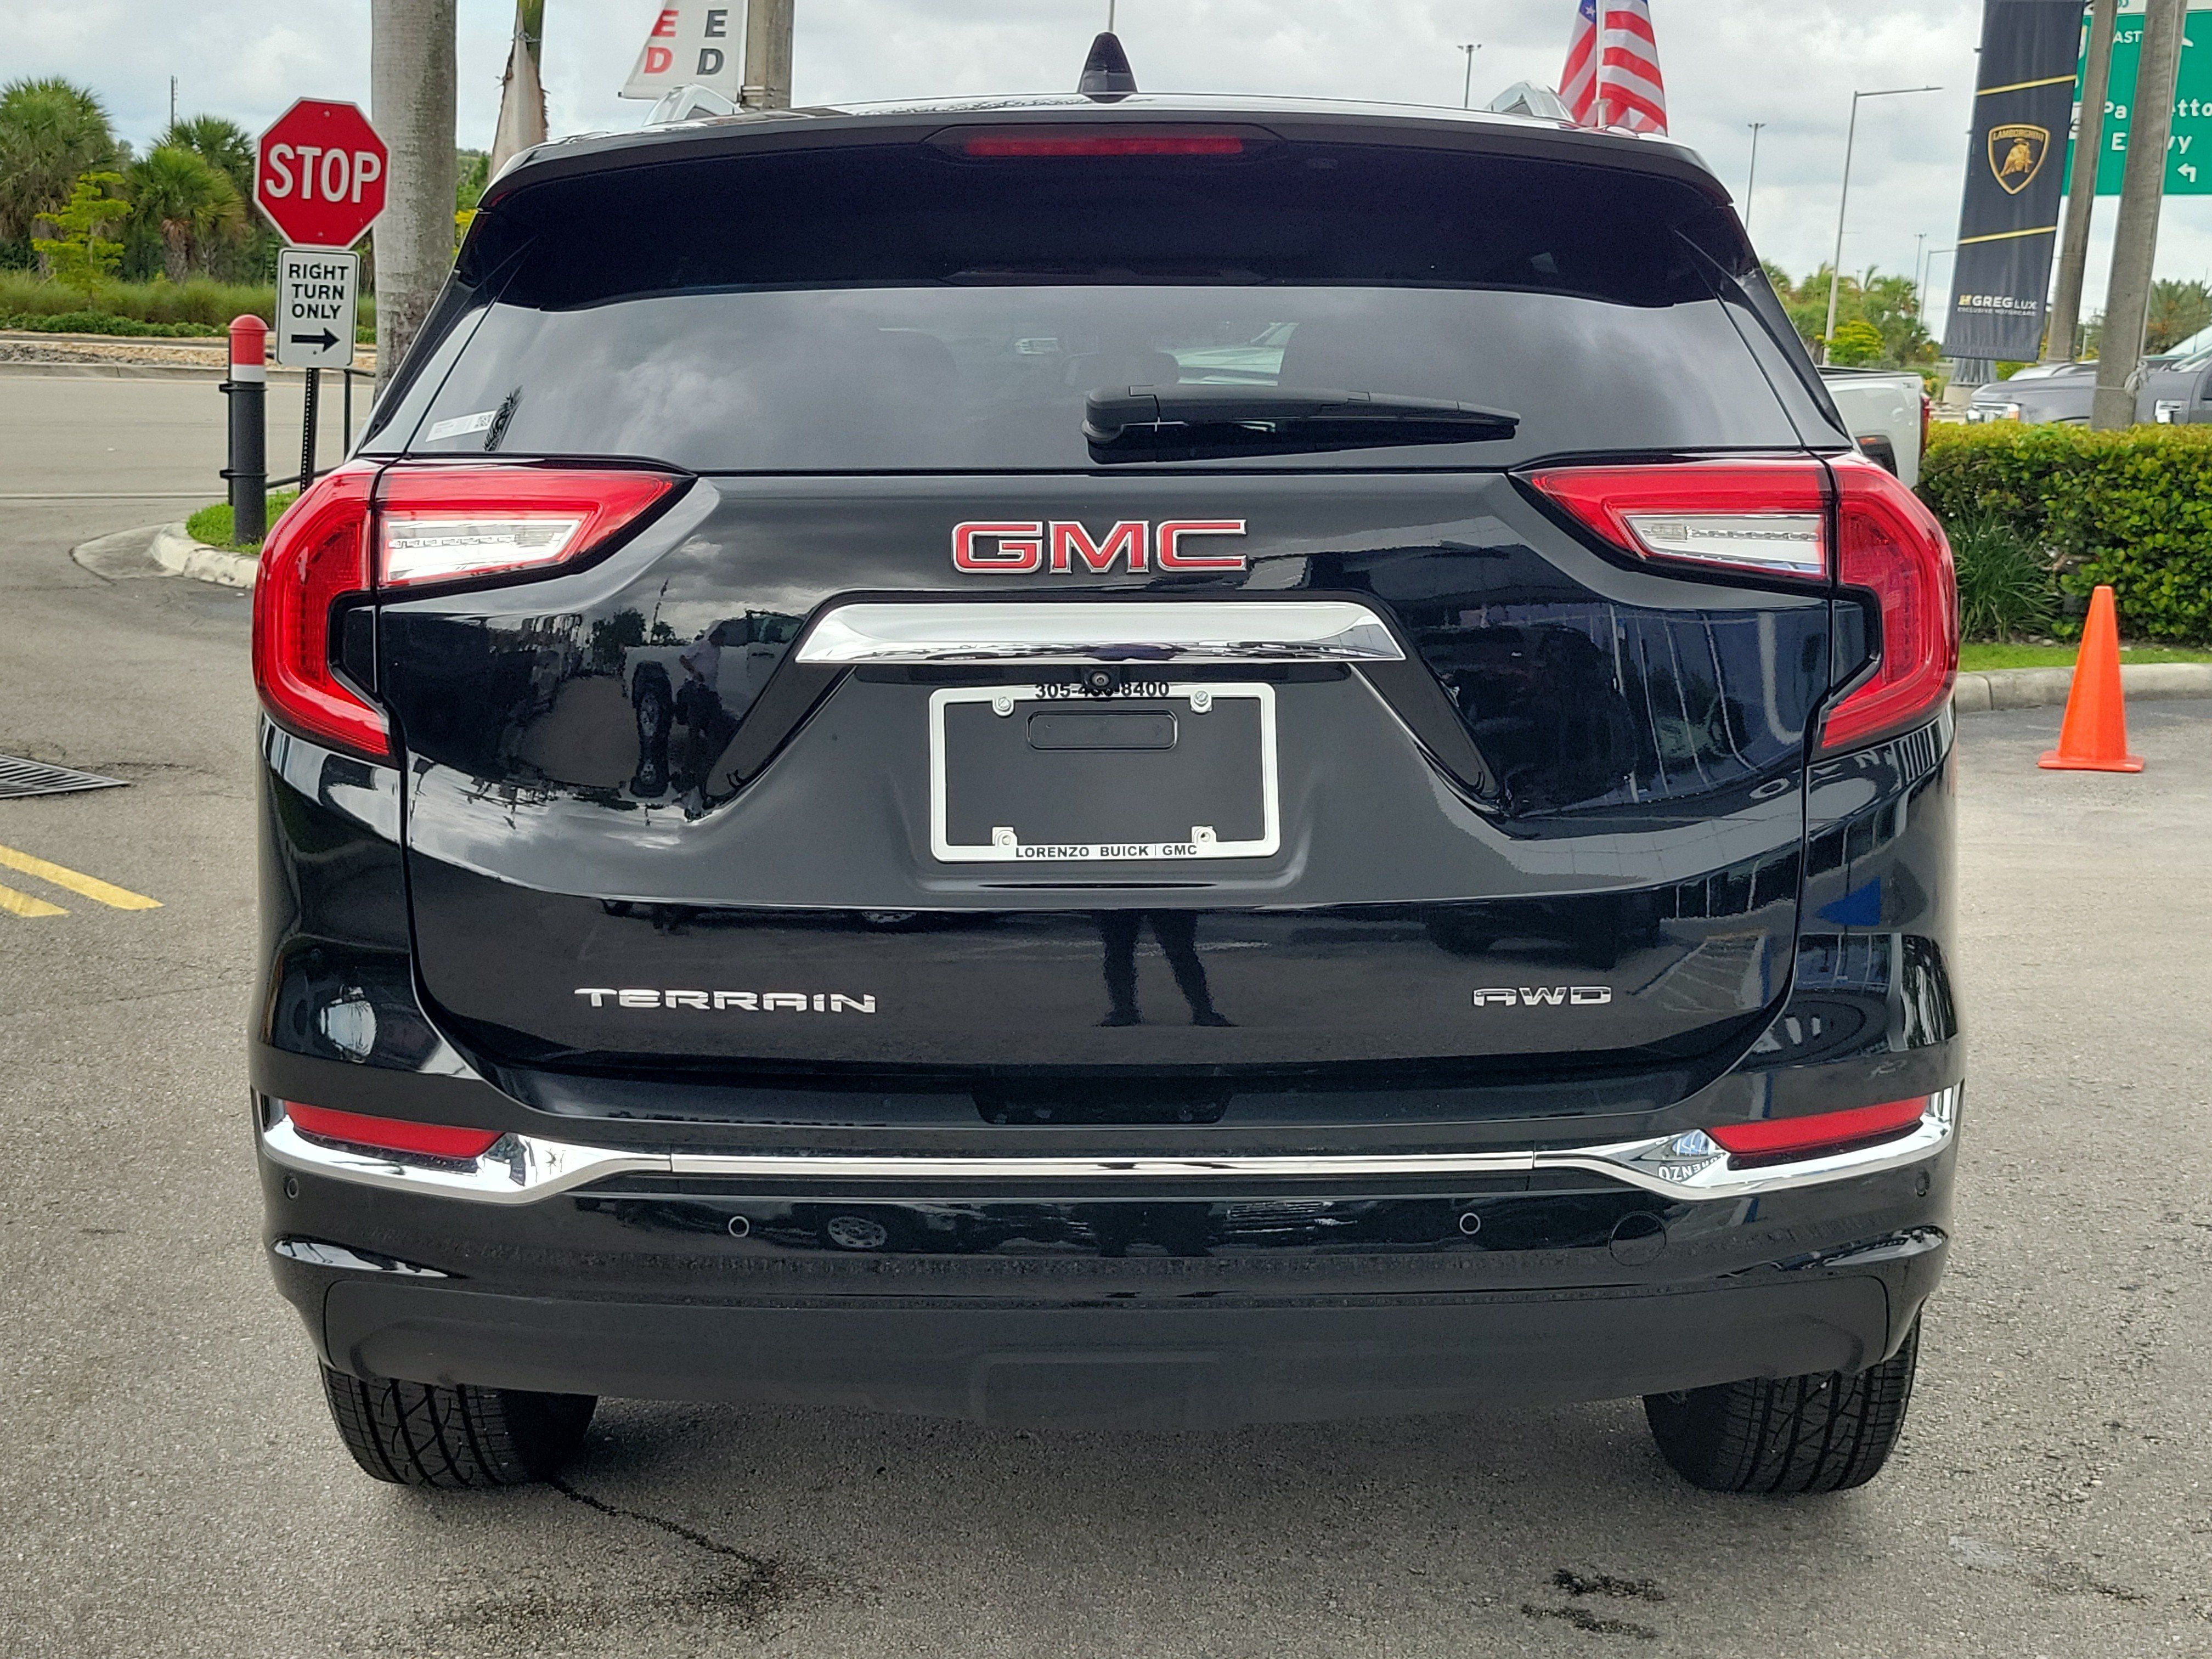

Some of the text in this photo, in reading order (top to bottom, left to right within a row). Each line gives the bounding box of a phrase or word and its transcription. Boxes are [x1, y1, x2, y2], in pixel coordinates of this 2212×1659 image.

[2113, 30, 2143, 43] AST
[264, 143, 381, 204] STOP
[289, 263, 349, 280] RIGHT
[291, 284, 344, 300] TURN
[292, 303, 341, 319] ONLY
[951, 519, 1247, 574] GMC
[1015, 845, 1197, 858] LORENZO BUICK GMC
[574, 988, 876, 1014] TERRAIN
[1473, 986, 1612, 1007] AWD
